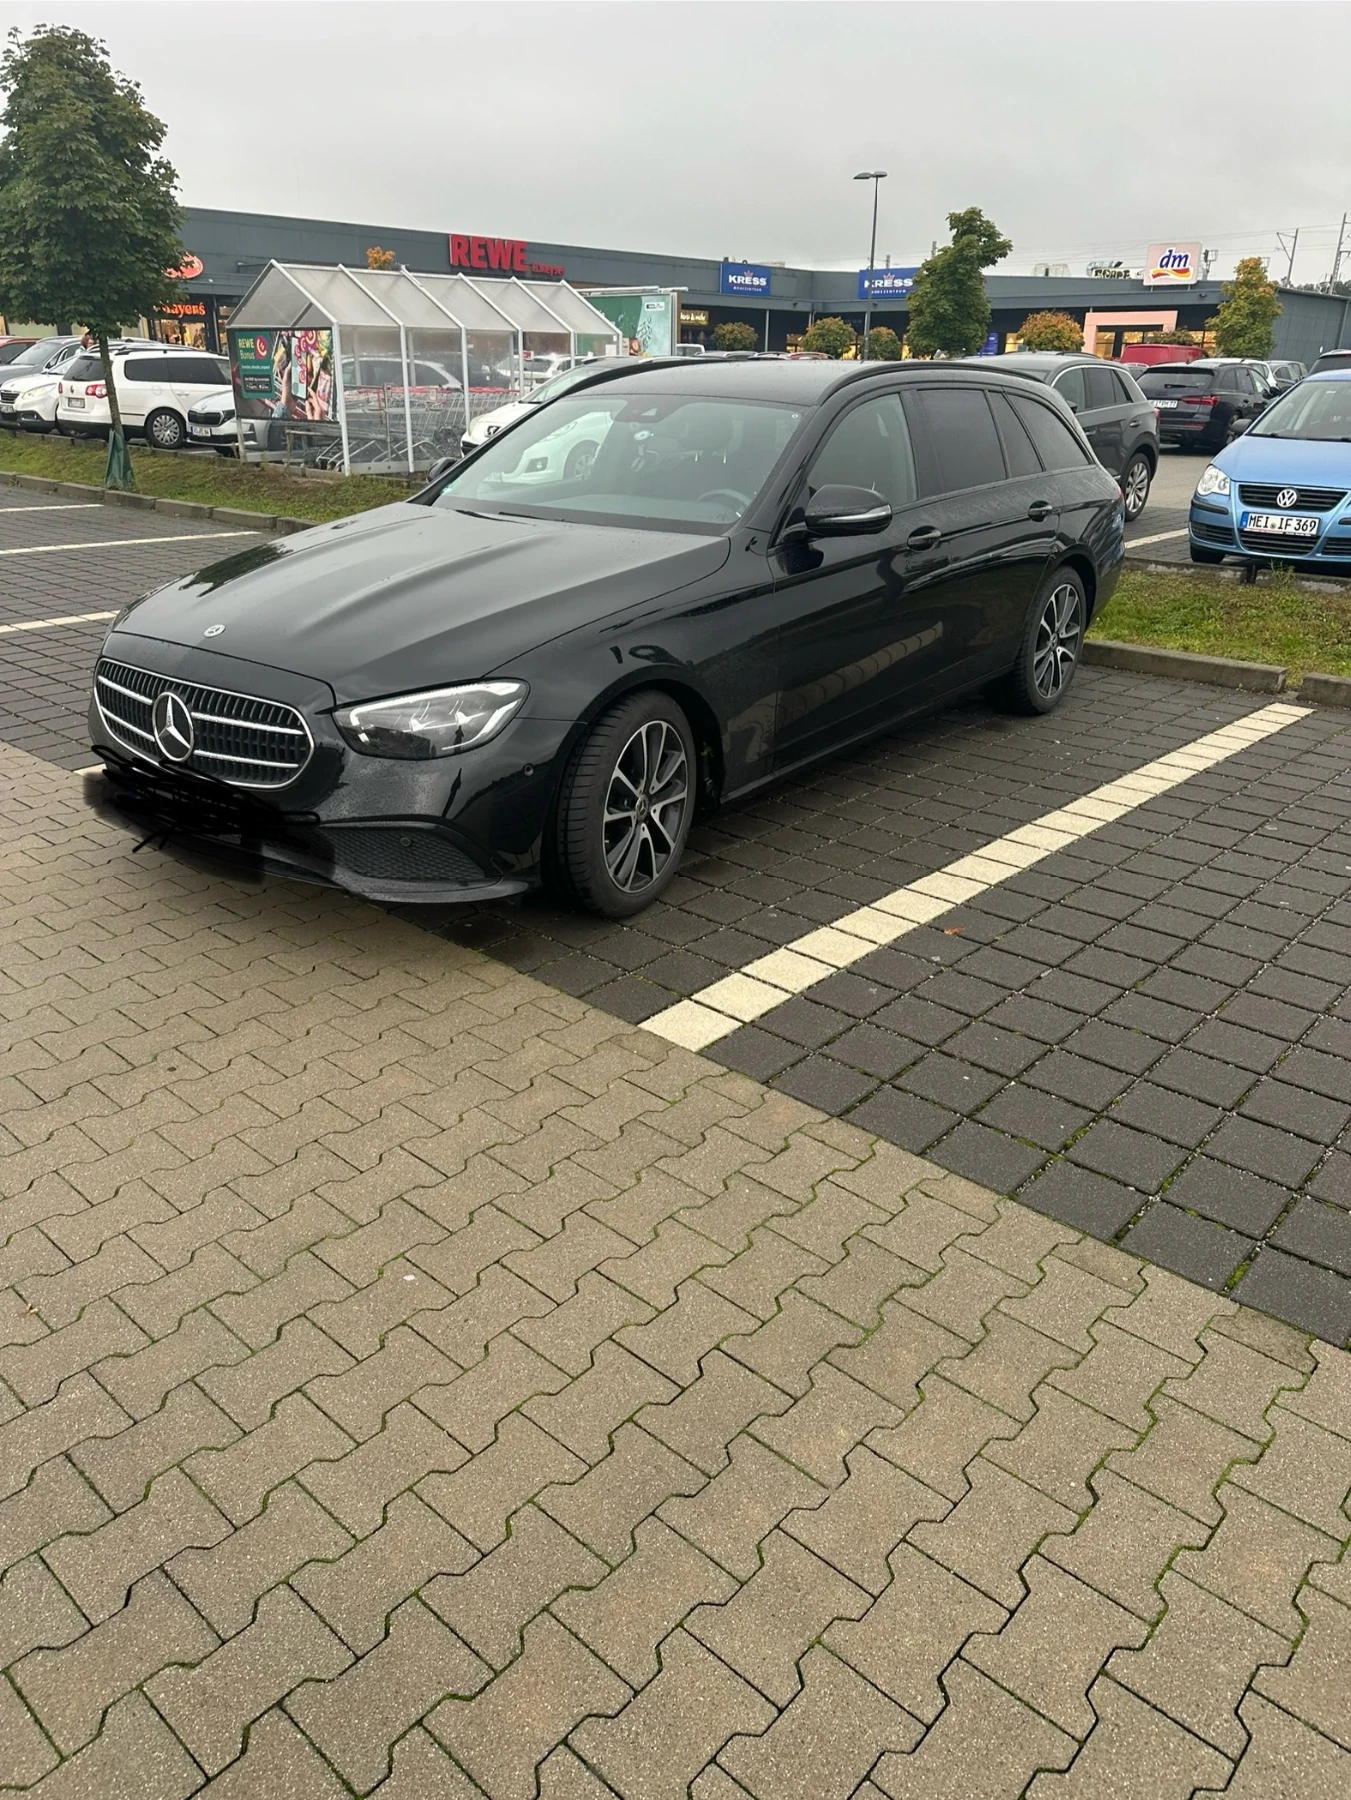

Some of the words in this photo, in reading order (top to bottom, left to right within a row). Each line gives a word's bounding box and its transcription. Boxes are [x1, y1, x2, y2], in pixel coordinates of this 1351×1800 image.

[449, 234, 528, 272] REWE
[1160, 249, 1190, 269] dm
[728, 275, 767, 286] KRESS
[864, 278, 913, 288] KRESS
[238, 338, 255, 348] REWE
[239, 350, 256, 360] Bonus
[1249, 515, 1269, 528] MEI
[1278, 517, 1293, 530] IF
[1294, 519, 1317, 532] 369
